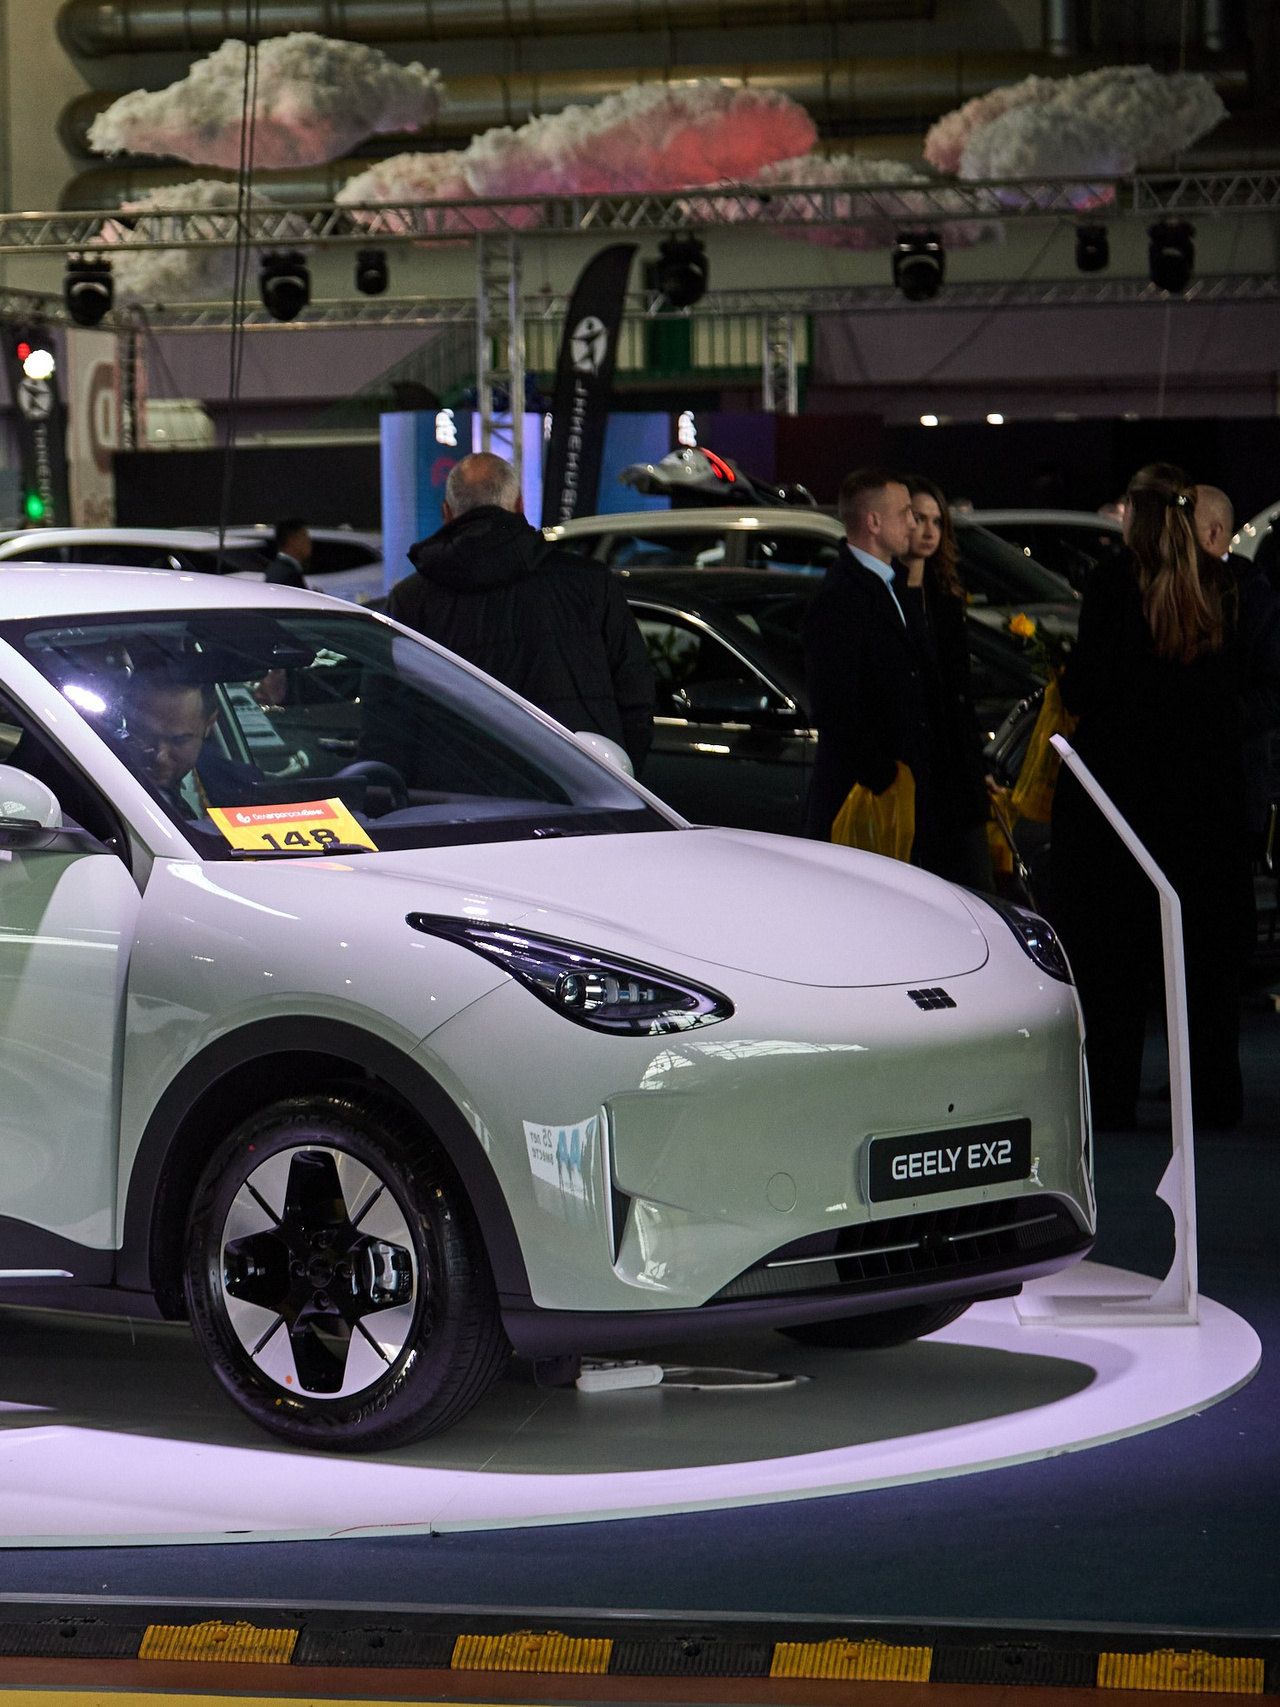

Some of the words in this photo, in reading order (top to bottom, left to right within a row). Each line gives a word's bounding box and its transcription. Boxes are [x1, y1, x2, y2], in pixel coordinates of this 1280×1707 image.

[261, 828, 340, 850] 148
[891, 1146, 963, 1181] GEELY
[968, 1139, 1012, 1170] EX2
